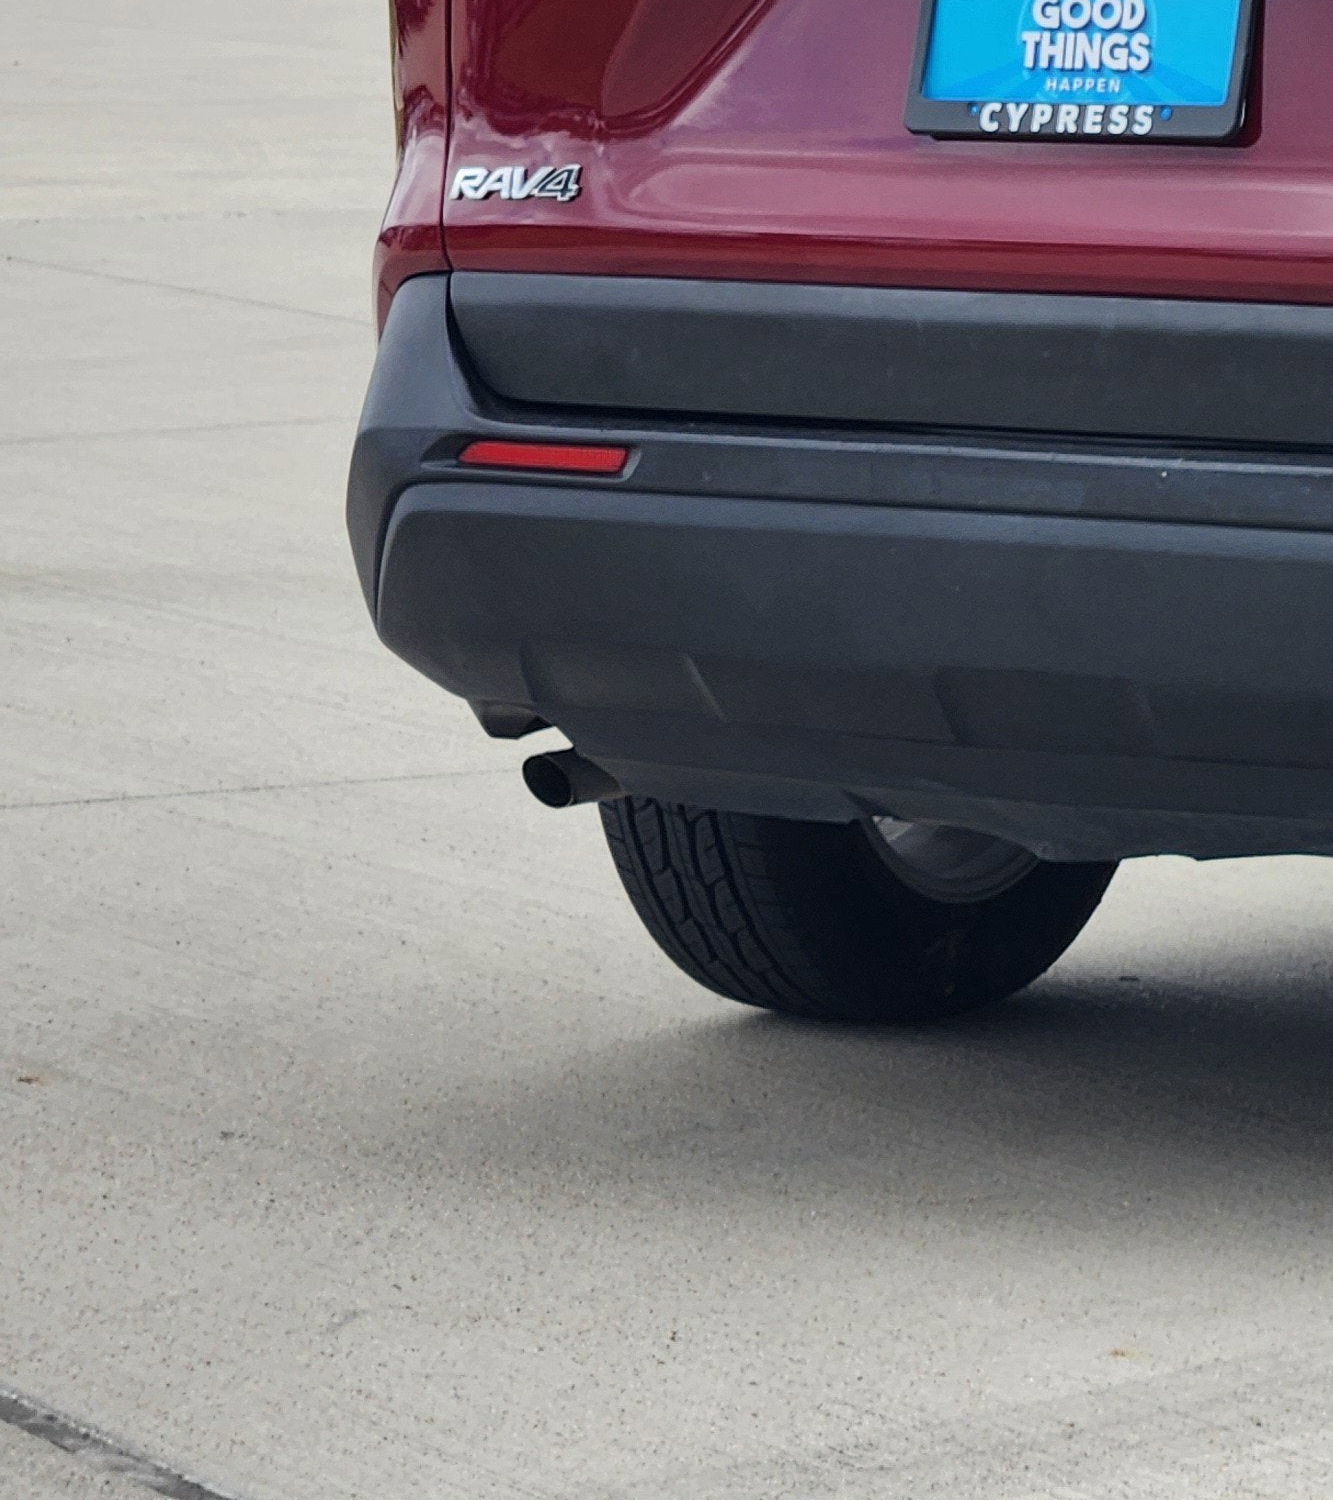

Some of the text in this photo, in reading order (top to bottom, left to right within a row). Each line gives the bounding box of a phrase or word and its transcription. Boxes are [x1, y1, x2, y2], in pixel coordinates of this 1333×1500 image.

[1021, 31, 1152, 72] THINGS
[1044, 78, 1121, 93] HAPPEN
[979, 101, 1155, 136] CYPRESS
[450, 163, 582, 202] RAV4
